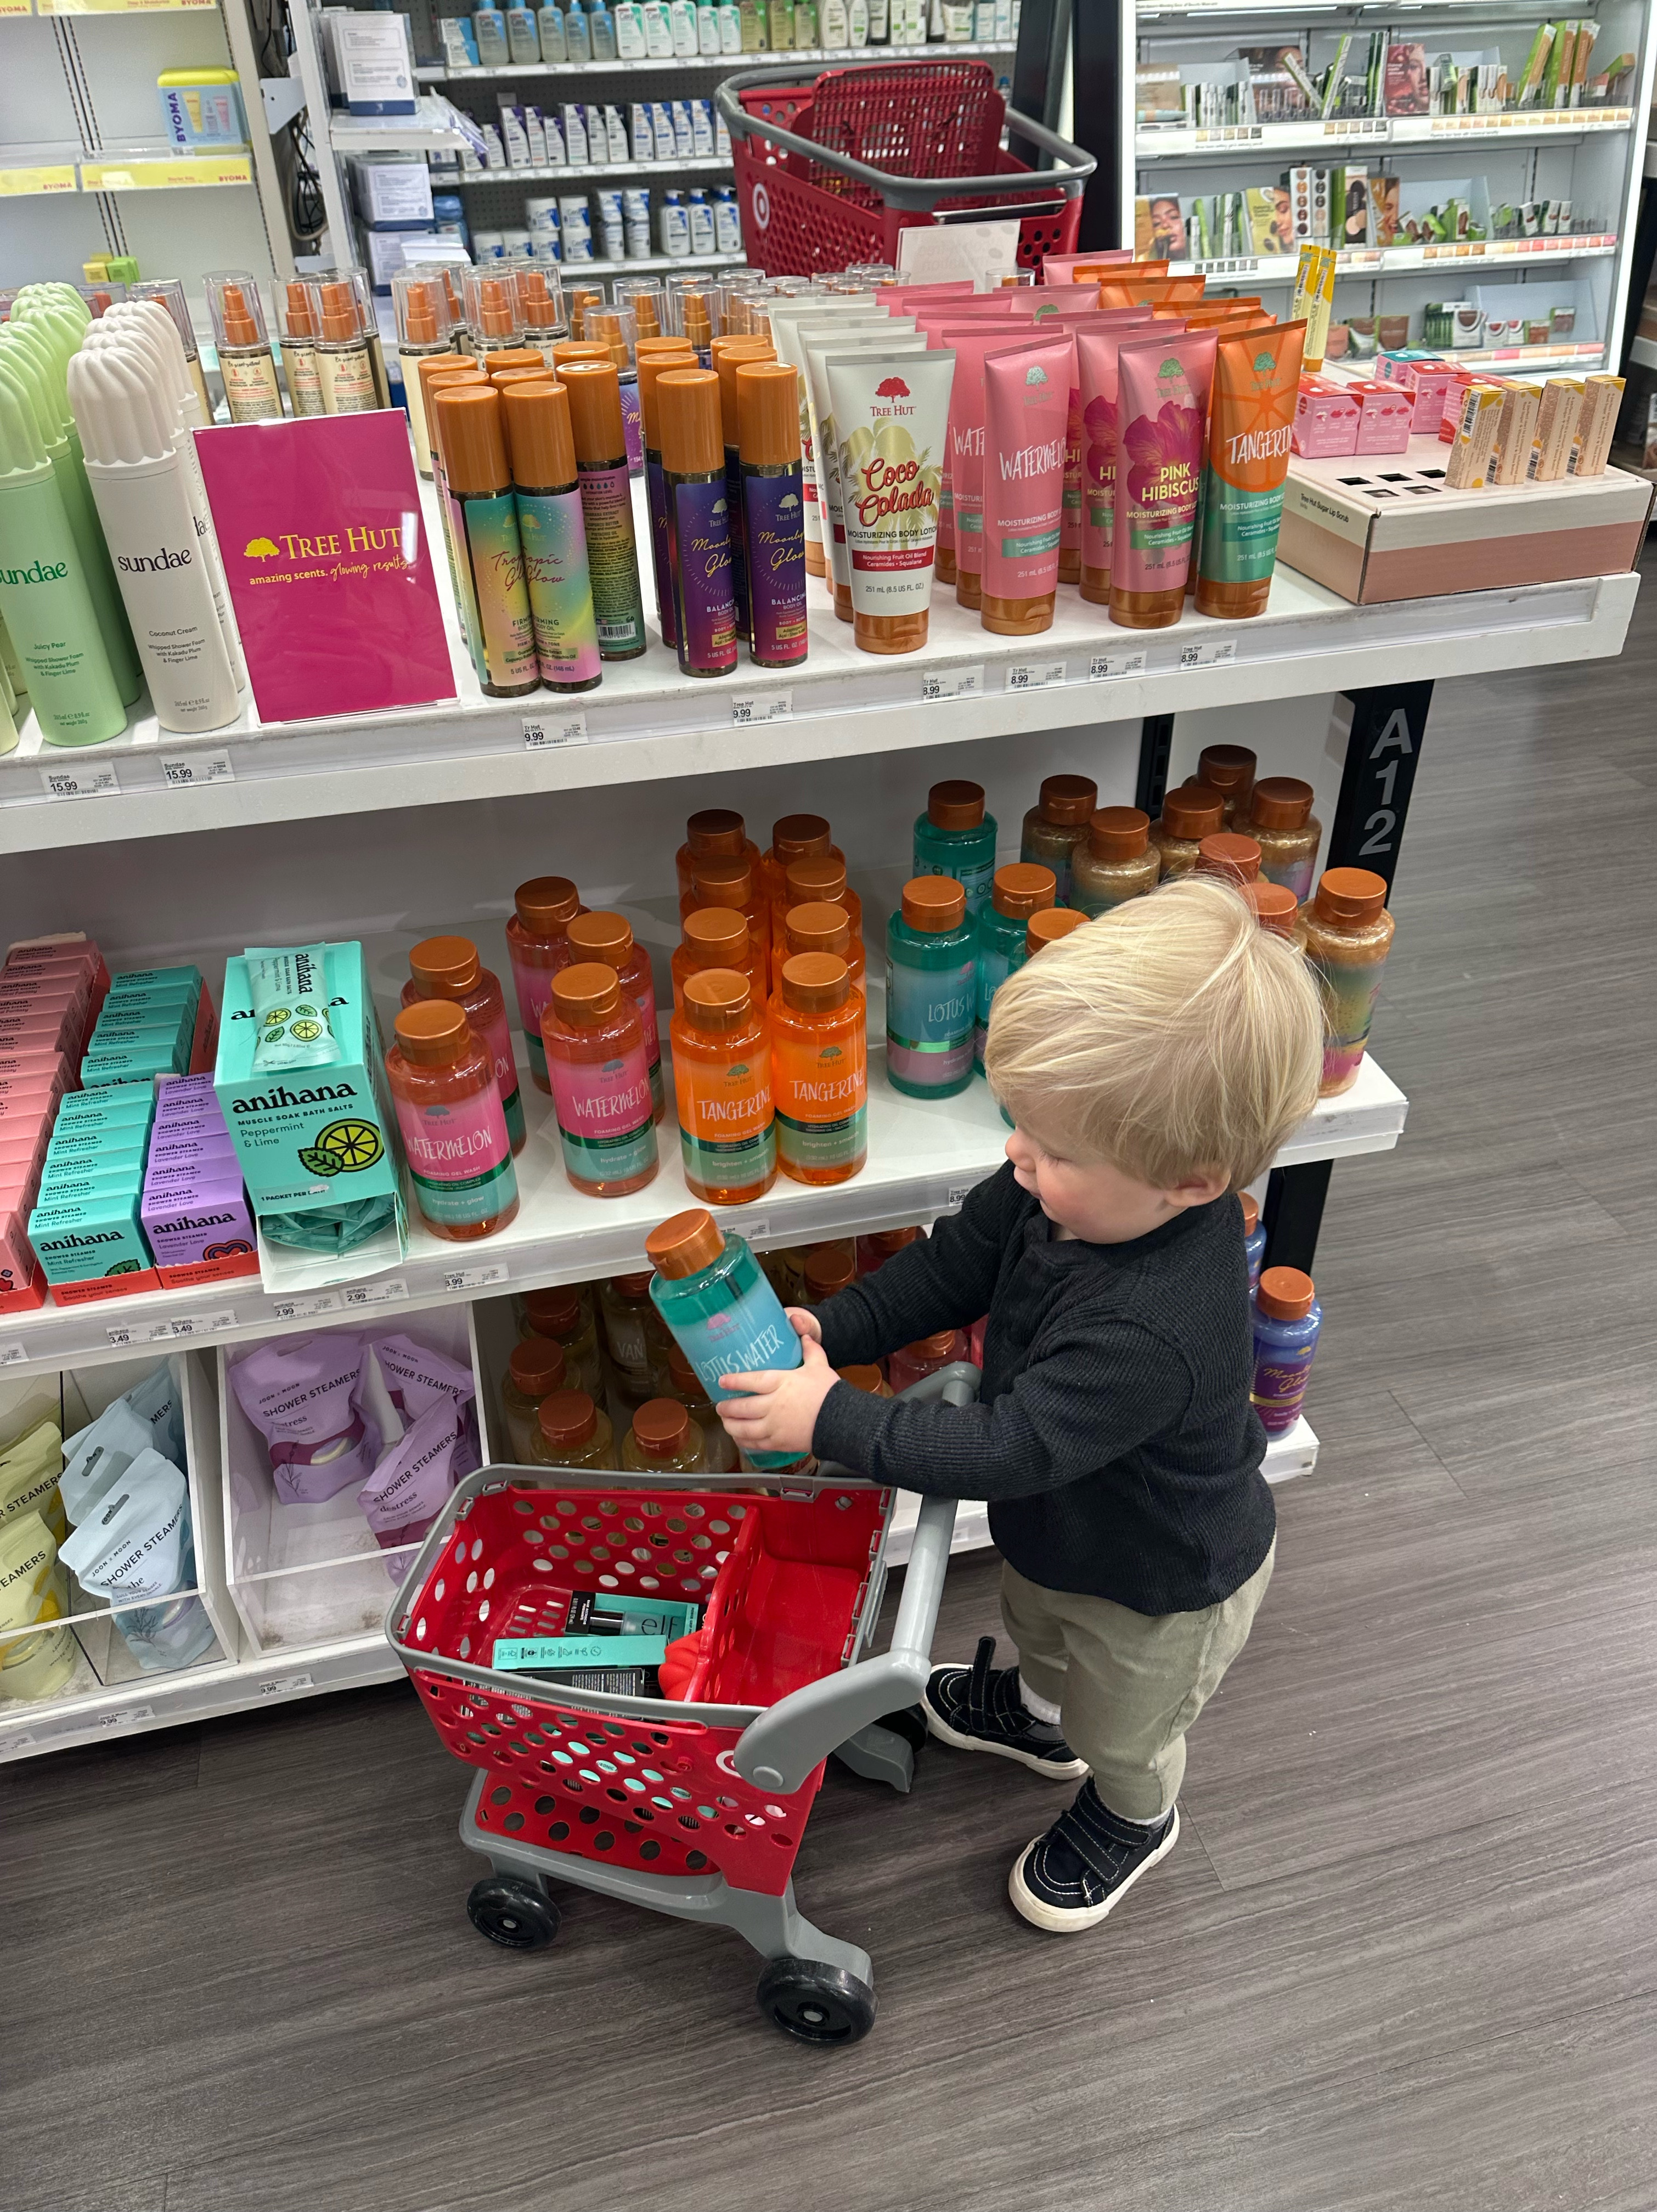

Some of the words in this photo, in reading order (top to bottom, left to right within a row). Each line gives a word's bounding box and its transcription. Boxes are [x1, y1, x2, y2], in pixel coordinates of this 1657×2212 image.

[168, 93, 186, 142] BYOMA
[870, 406, 892, 416] TREE
[894, 405, 915, 415] HUT
[999, 437, 1066, 481] WATERMELO
[861, 458, 920, 492] Coco
[1160, 462, 1191, 482] PINK
[1142, 477, 1199, 502] HIBISCUS
[855, 481, 934, 527] Colada
[1220, 498, 1269, 510] MOISTURIZING
[1126, 507, 1177, 518] MOISTURIZING
[1317, 501, 1329, 512] Sugar
[1336, 511, 1349, 522] Scrub
[998, 514, 1046, 527] MOISTURIZING
[1237, 522, 1264, 531] Nourishing
[848, 530, 897, 539] MOISTURIZING
[899, 529, 918, 538] BODY
[280, 534, 342, 560] TREE
[345, 526, 402, 552] HUT
[1148, 538, 1174, 546] Ceramides
[118, 548, 192, 572] sundae
[863, 554, 891, 562] Nourishing
[899, 558, 922, 567] Squalane
[249, 573, 292, 585] amazing
[294, 569, 328, 581] scents.
[329, 563, 370, 582] glowing
[887, 584, 897, 594] (8.5
[177, 626, 198, 635] Cream
[172, 641, 191, 650] Shower
[168, 648, 187, 657] Kakadu
[1181, 653, 1198, 663] 8.99
[1091, 664, 1108, 674] 8.99
[1011, 675, 1028, 684] 8.99
[923, 685, 940, 695] 8.99
[733, 709, 751, 718] 9.99
[525, 732, 544, 741] 9.99
[166, 769, 193, 780] 15.99
[50, 781, 78, 792] 15.99
[295, 953, 317, 995] anihana
[928, 996, 965, 1023] LOTUS
[166, 1076, 206, 1086] anihana
[789, 1065, 865, 1102] TANGERINE
[68, 1091, 108, 1099] anihana
[232, 1083, 358, 1114] anihana
[573, 1077, 649, 1119] WATERMELON
[163, 1098, 204, 1108] anihana
[697, 1084, 771, 1122] TANGERINE
[61, 1112, 103, 1121] anihana
[238, 1117, 273, 1125] MUSCLE
[276, 1113, 300, 1121] SOAK
[158, 1120, 199, 1130] anihana
[240, 1122, 305, 1137] Peppermint
[55, 1136, 97, 1146] anihana
[255, 1138, 279, 1147] Lime
[404, 1125, 492, 1161] WATERMELON
[155, 1142, 198, 1152] anihana
[50, 1159, 93, 1169] anihana
[600, 1154, 627, 1164] hydrate
[153, 1165, 195, 1176] anihana
[464, 1166, 480, 1174] WASH
[46, 1181, 90, 1191] anihana
[149, 1189, 193, 1201] anihana
[467, 1196, 484, 1205] glow
[37, 1207, 81, 1217] anihana
[153, 1213, 237, 1234] anihana
[40, 1231, 125, 1251] anihana
[347, 1293, 366, 1302] 2.99
[276, 1307, 294, 1317] 2.99
[172, 1325, 193, 1334] 3.49
[110, 1334, 129, 1344] 3.49
[736, 1324, 785, 1372] WATER
[263, 1394, 307, 1417] SHOWER
[309, 1369, 360, 1398] STEAMERS
[282, 1383, 300, 1393] MOON
[373, 1471, 413, 1502] SHOWER
[413, 1431, 457, 1472] STEAMERS
[7, 1472, 63, 1512] STEAMERS
[100, 1549, 144, 1586] SHOWER
[144, 1504, 183, 1551] STEAMERS
[92, 1561, 108, 1577] JOON
[114, 1540, 131, 1557] MOON
[0, 1551, 46, 1591] EAMERS
[641, 1615, 685, 1639] elf
